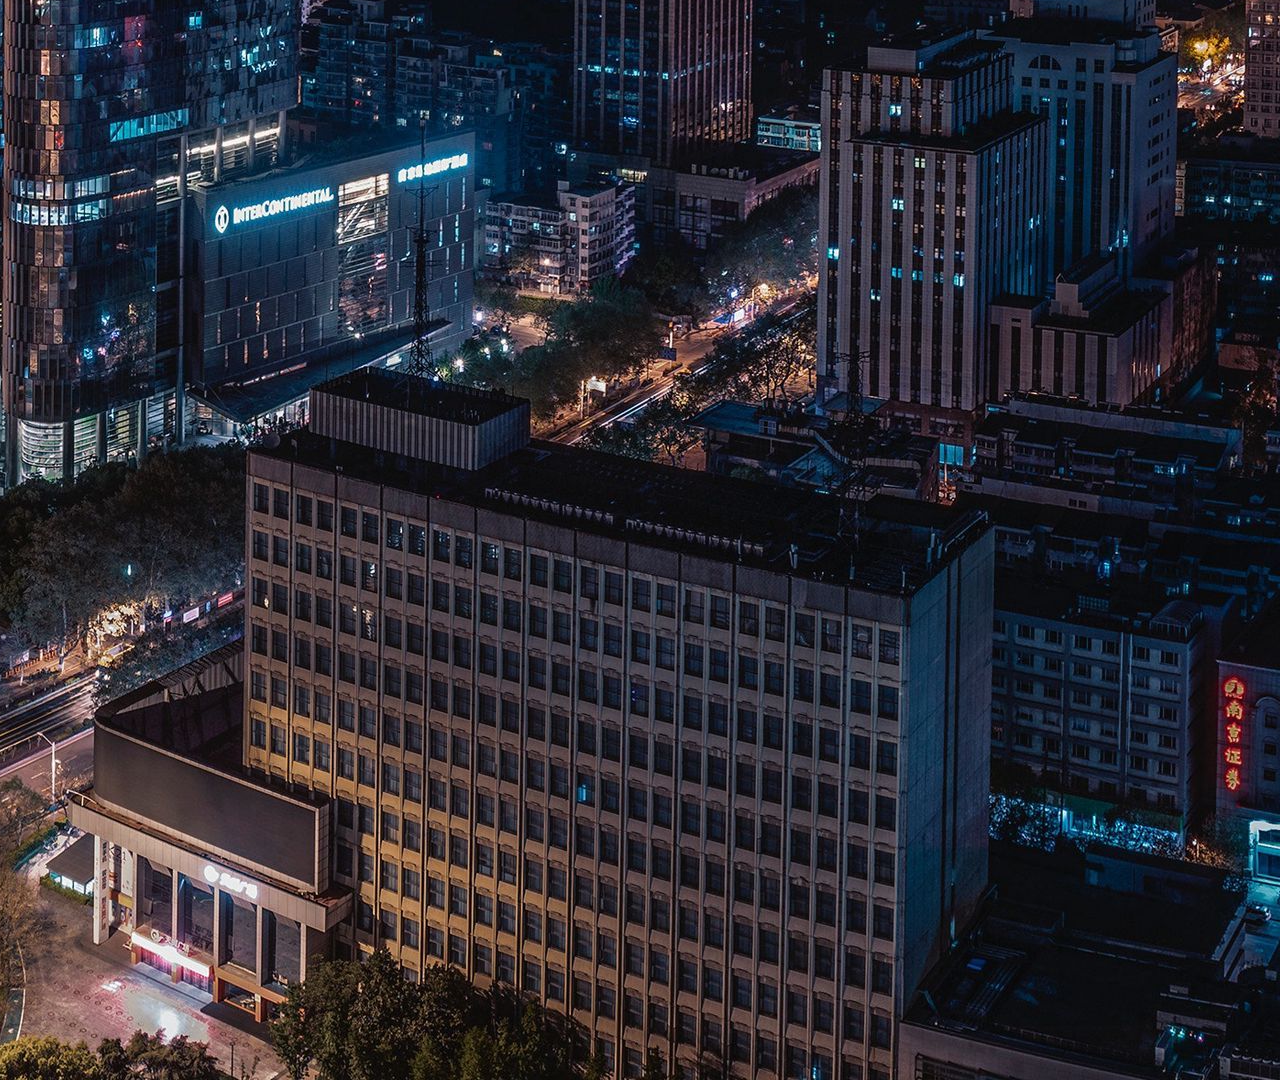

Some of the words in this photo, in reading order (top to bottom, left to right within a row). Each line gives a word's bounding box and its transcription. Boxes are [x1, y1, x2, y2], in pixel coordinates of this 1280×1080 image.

[233, 187, 334, 224] INTERCONTINENTAL
[1225, 700, 1242, 790] 南京证券
